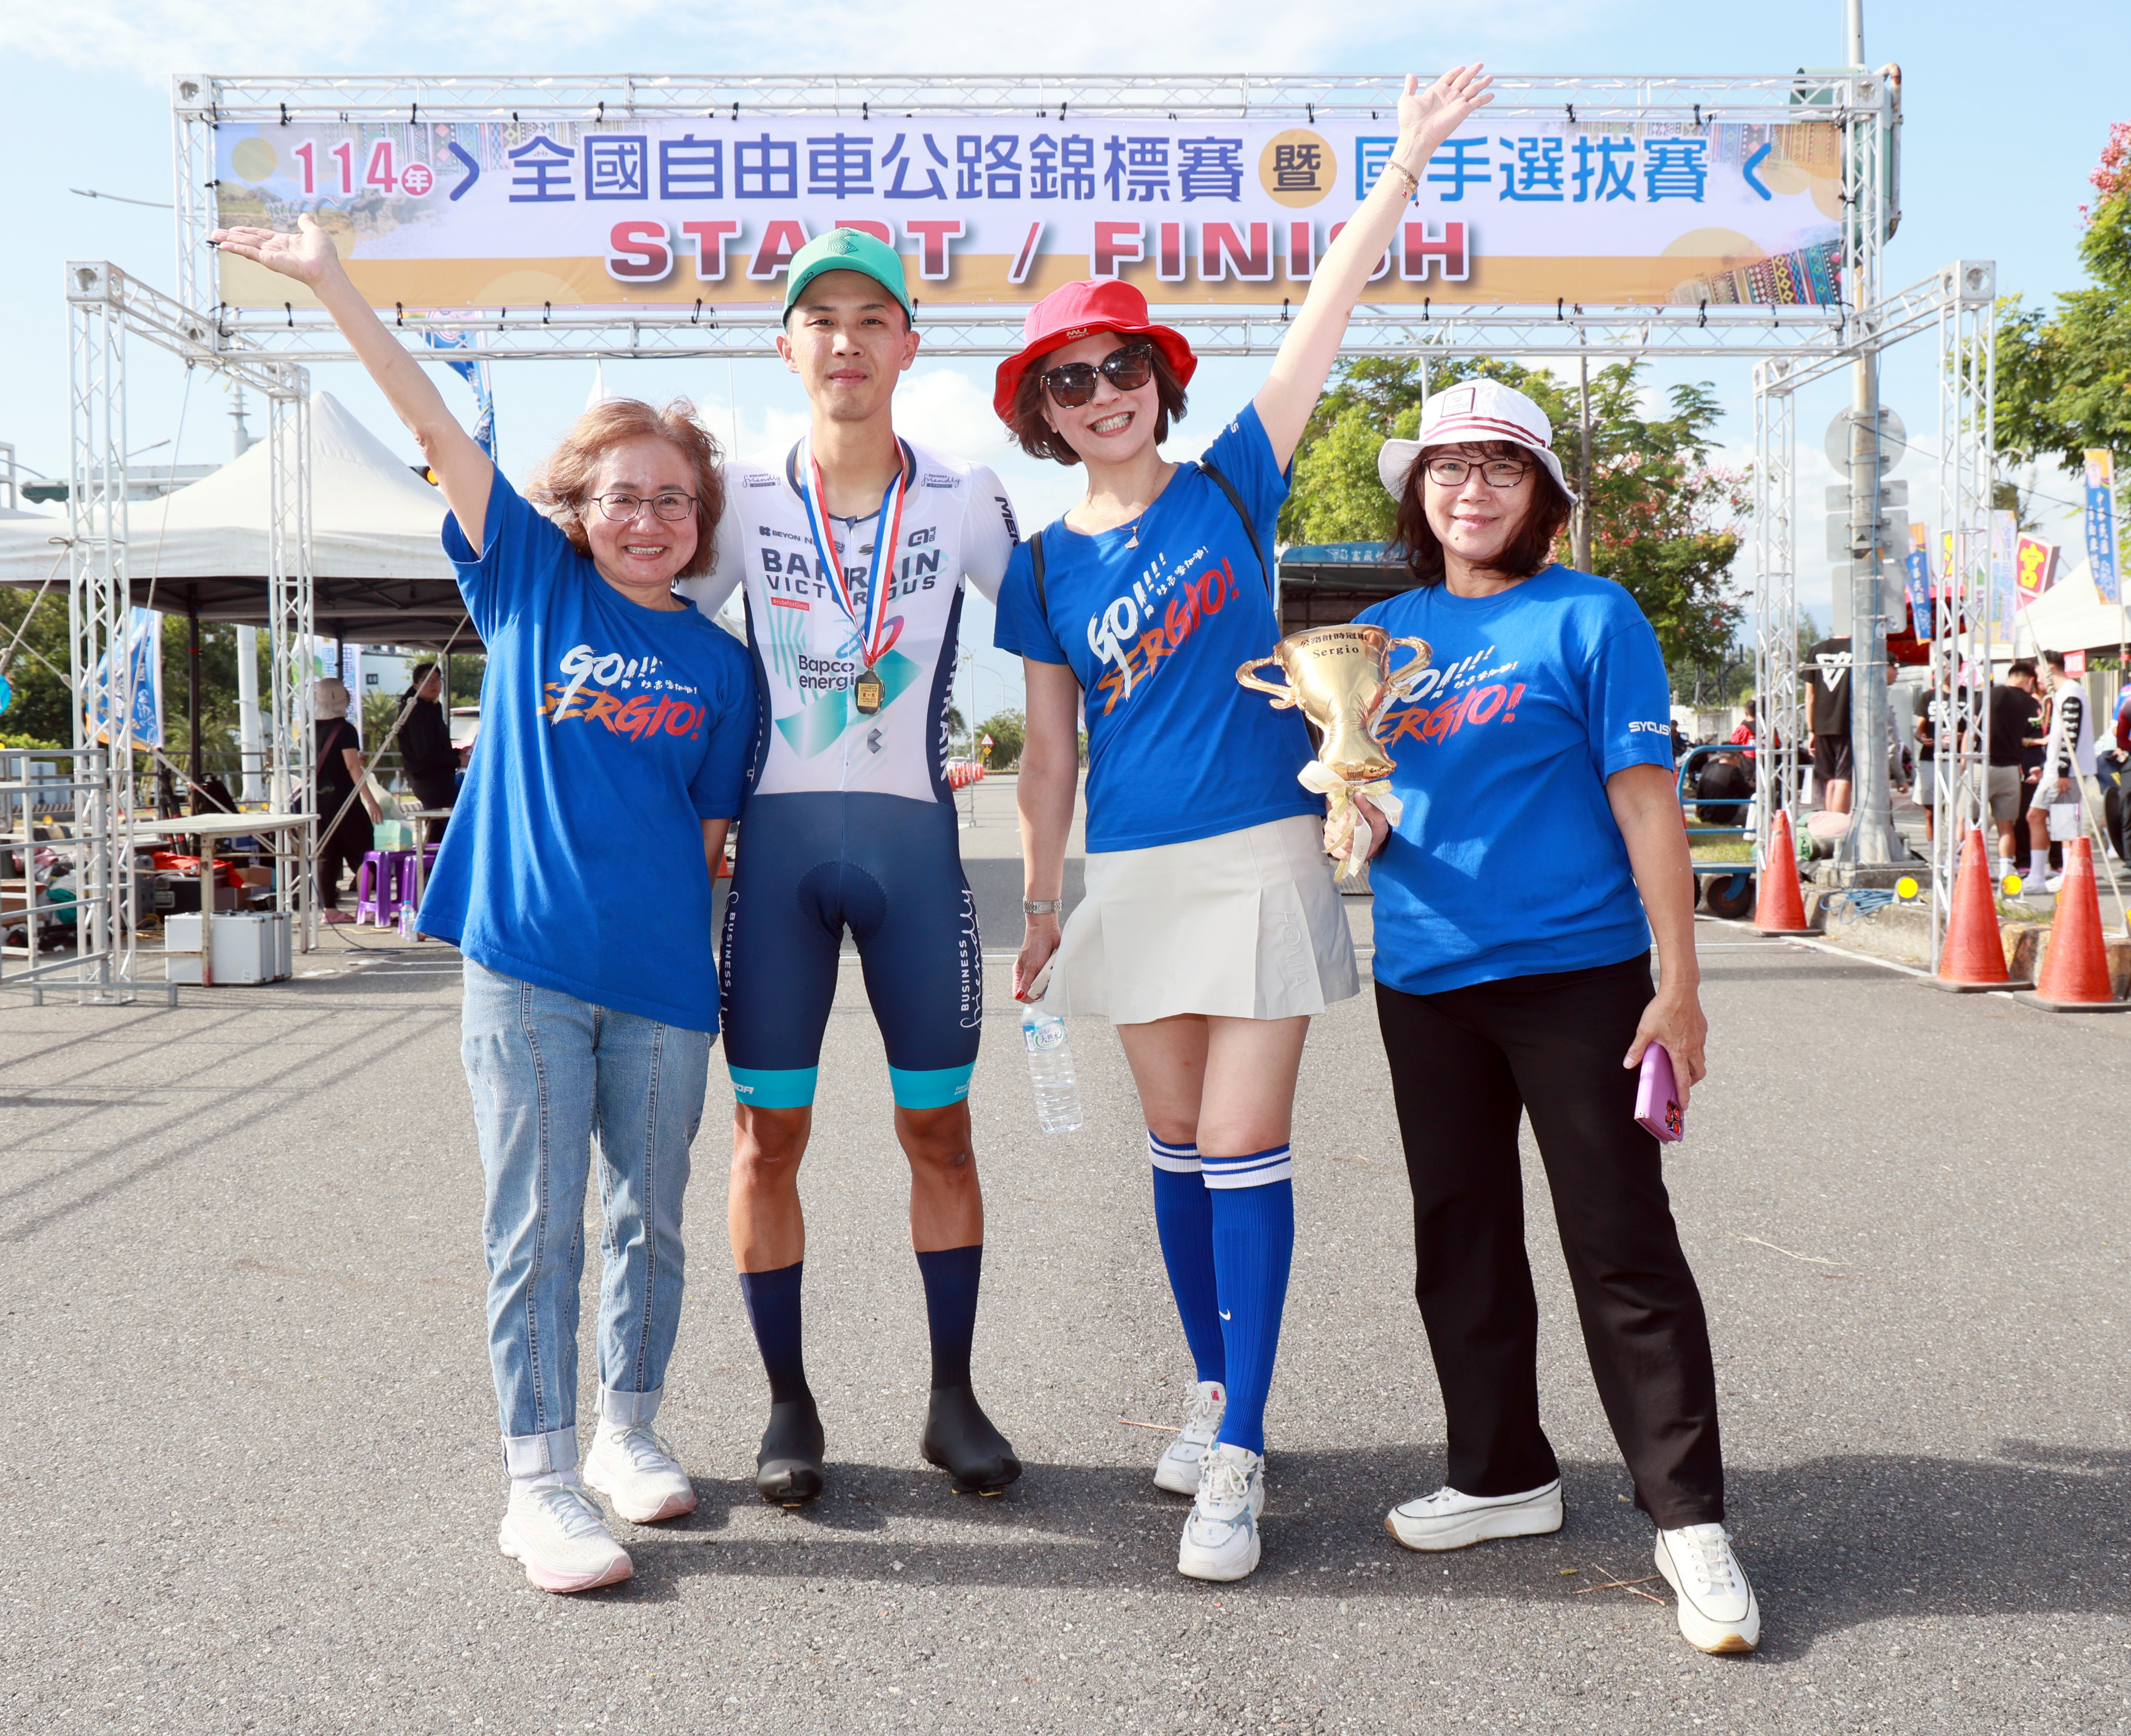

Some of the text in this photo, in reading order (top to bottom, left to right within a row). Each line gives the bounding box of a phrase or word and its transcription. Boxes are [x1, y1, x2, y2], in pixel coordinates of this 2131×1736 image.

[508, 132, 1244, 202] 全國自由車公路錦標賽
[1273, 143, 1322, 191] 暨
[610, 220, 960, 277] STAT
[1095, 221, 1464, 277] FINIH
[742, 473, 781, 488] friendly
[921, 473, 962, 488] friendly
[772, 530, 801, 541] BEYON
[761, 548, 940, 591] BARIN
[772, 598, 808, 610] #rideforGino
[1313, 645, 1359, 659] Sergio
[799, 655, 855, 676] Bapco
[799, 672, 864, 691] energi
[1377, 683, 1526, 748] ERGIO!
[1628, 721, 1671, 736] SYCLIS
[725, 912, 736, 987] BUSINESS
[959, 940, 970, 1011] BUSINESS
[732, 1082, 754, 1094] IDA
